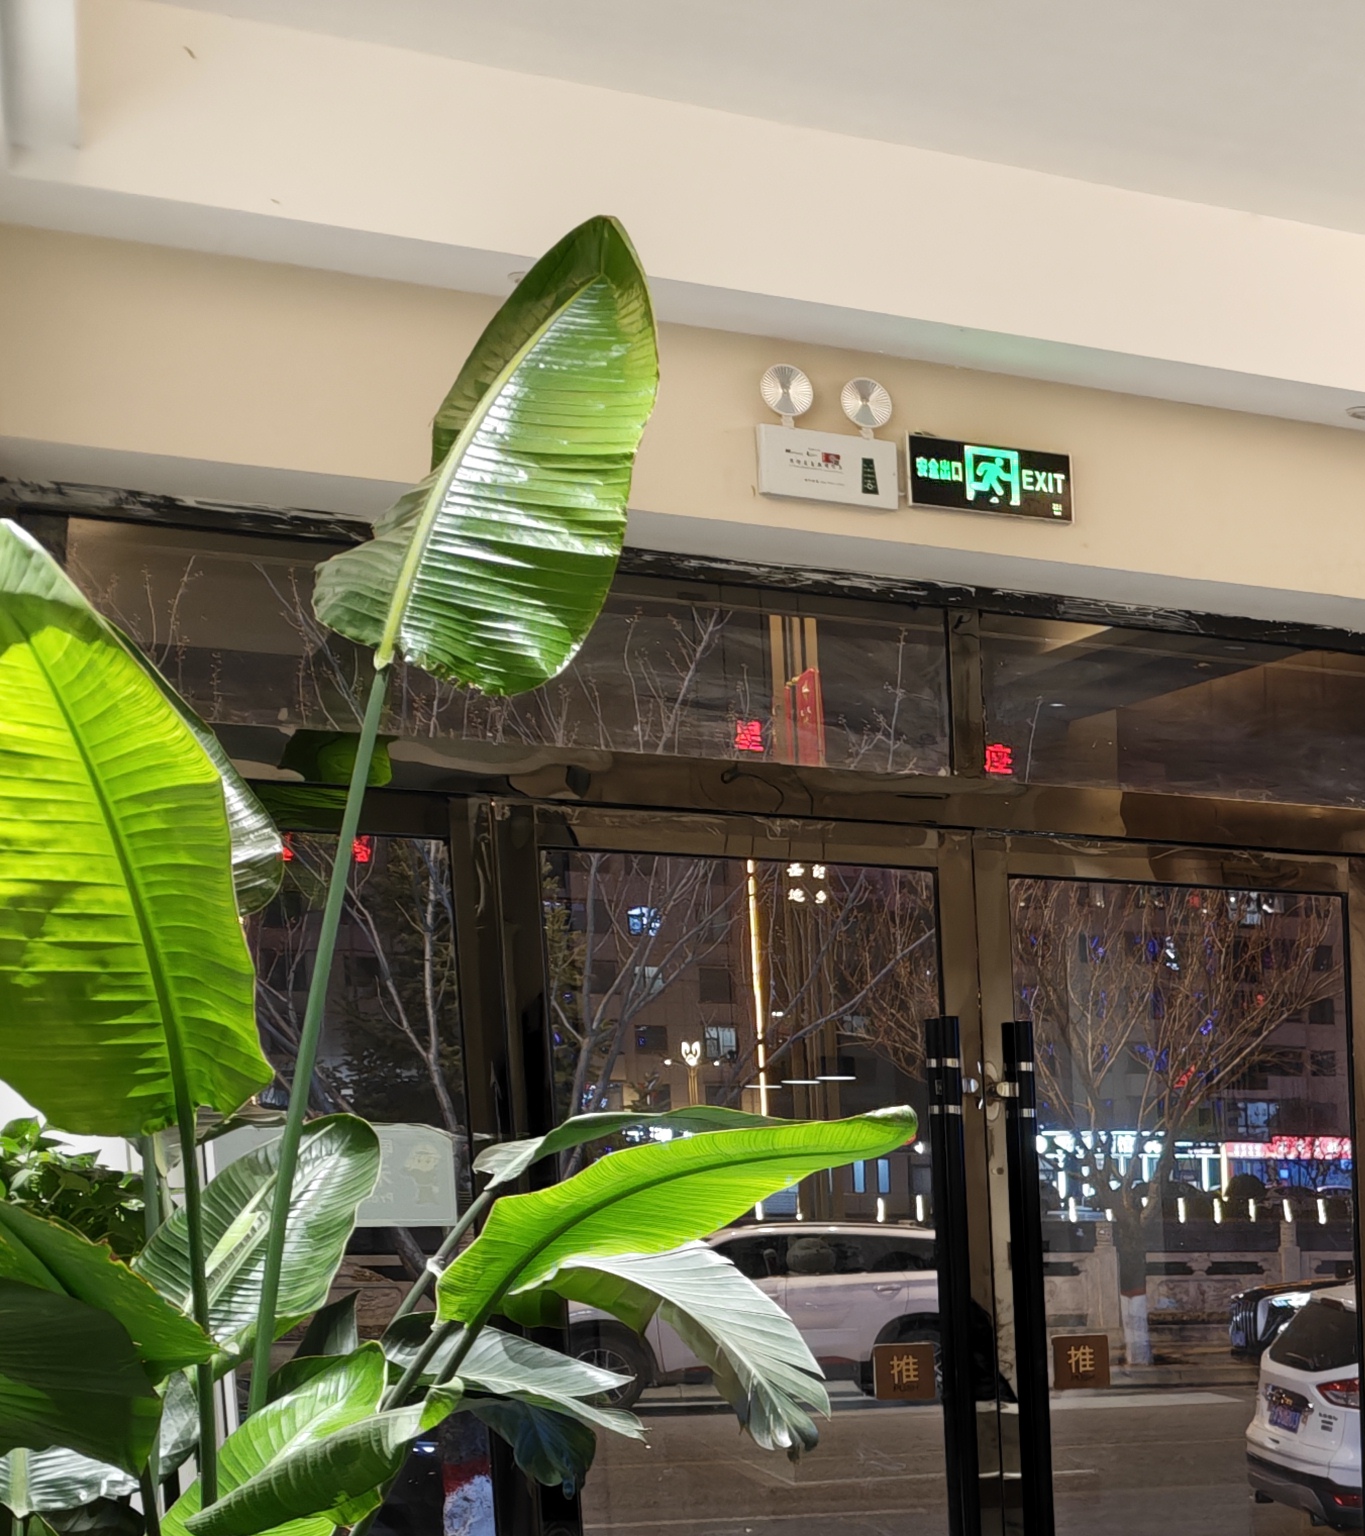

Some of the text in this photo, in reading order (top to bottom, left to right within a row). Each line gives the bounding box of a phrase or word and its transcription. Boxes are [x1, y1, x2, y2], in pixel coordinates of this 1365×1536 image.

[915, 456, 963, 483] 安全出口
[1021, 468, 1066, 495] EXIT
[889, 1354, 920, 1385] 推
[1067, 1343, 1095, 1374] 推
